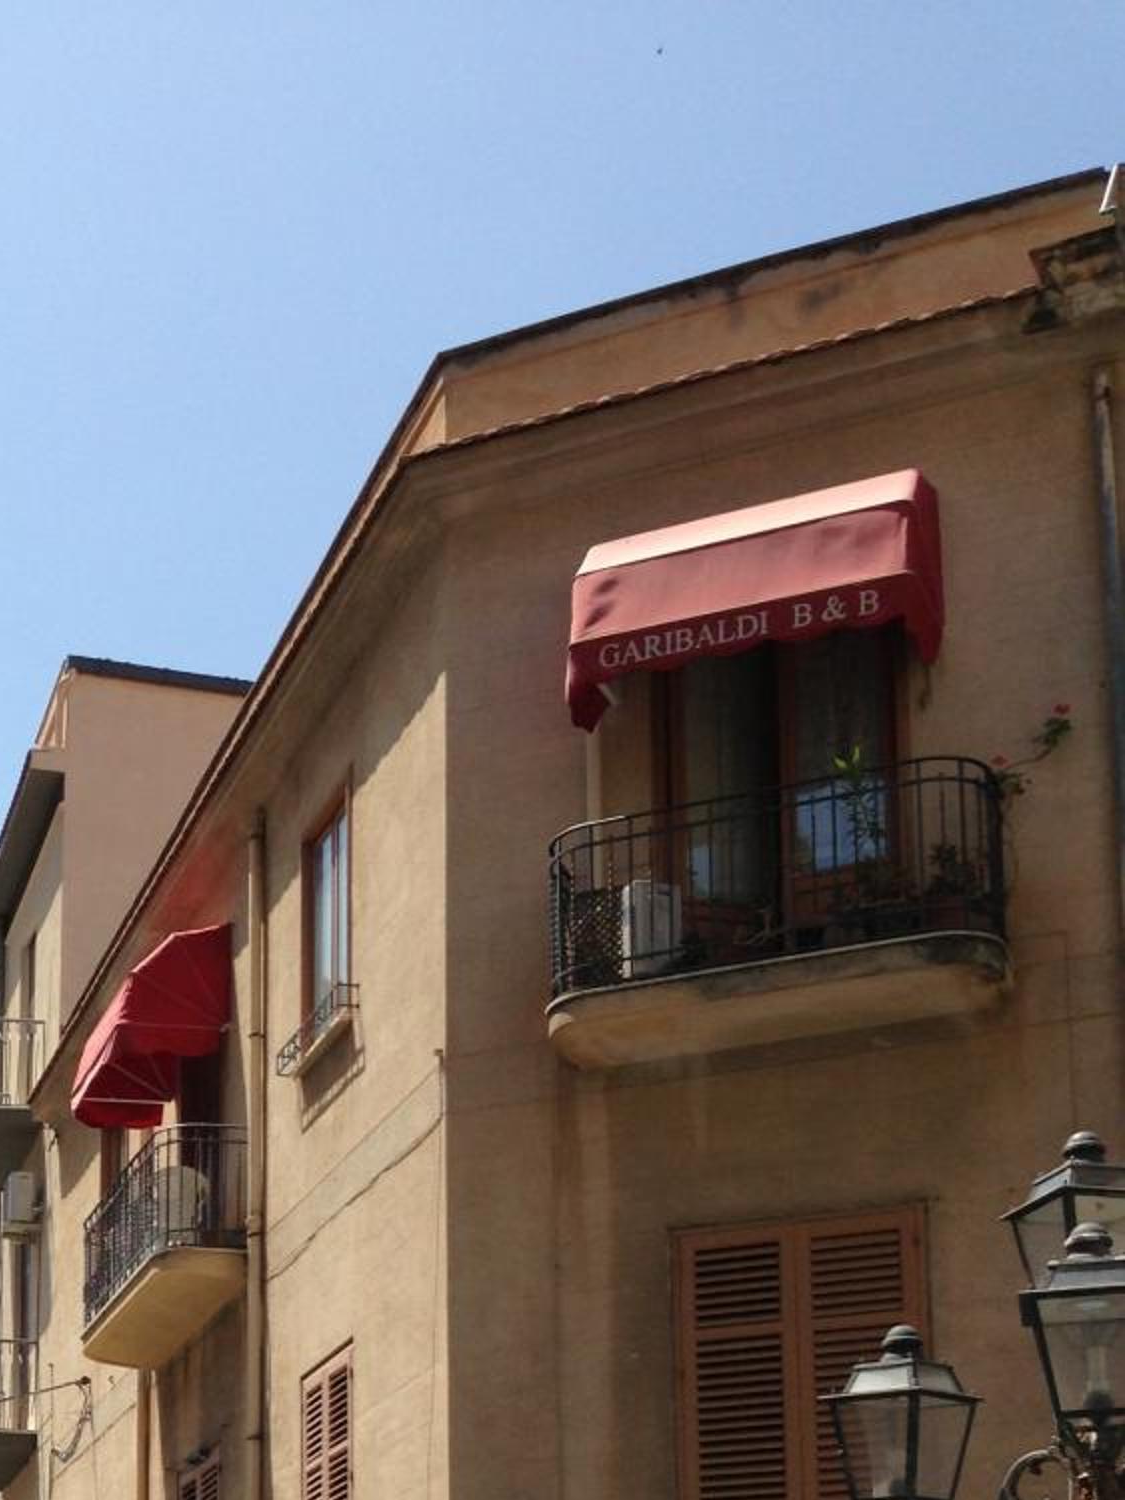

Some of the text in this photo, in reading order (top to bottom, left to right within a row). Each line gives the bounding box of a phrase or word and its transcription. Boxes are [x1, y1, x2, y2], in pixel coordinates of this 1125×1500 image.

[598, 590, 881, 668] GARIBALDI B & B
